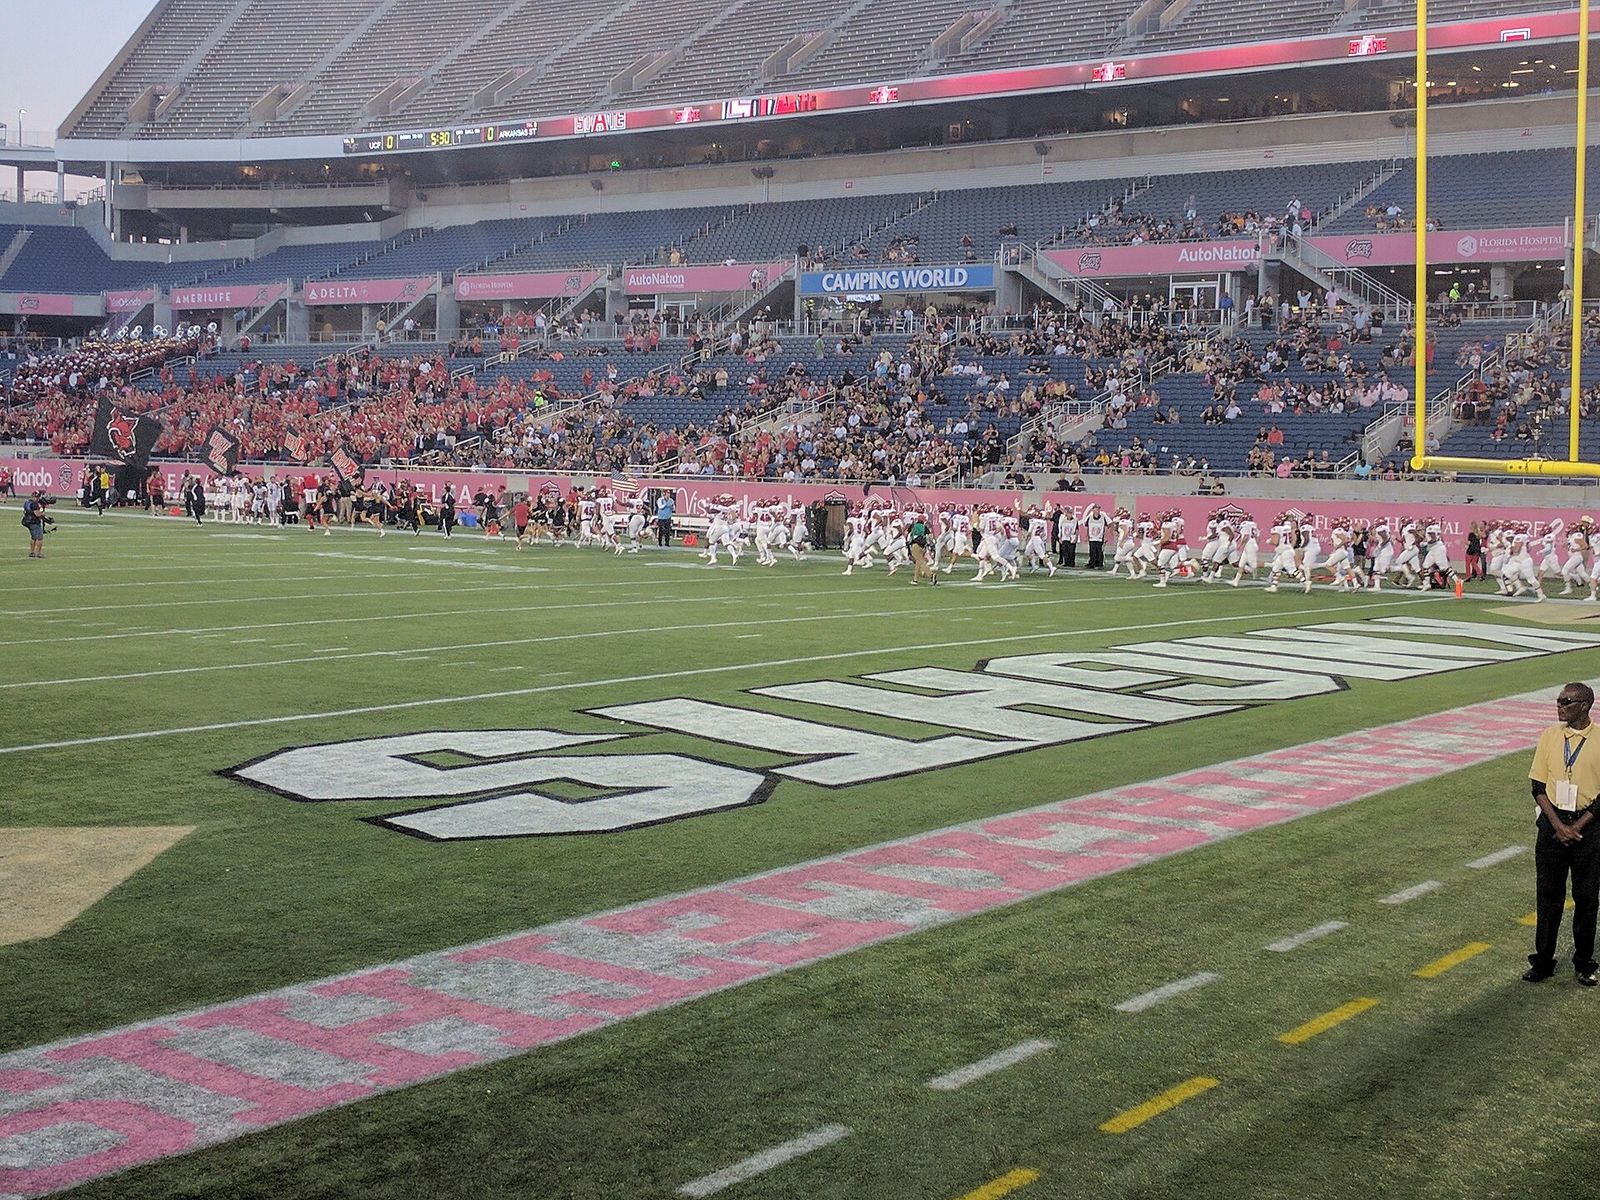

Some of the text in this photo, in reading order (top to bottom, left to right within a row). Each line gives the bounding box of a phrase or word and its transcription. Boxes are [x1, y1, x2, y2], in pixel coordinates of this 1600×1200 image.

[574, 111, 626, 134] STATE
[431, 131, 450, 146] 5:30
[487, 127, 494, 141] 0
[499, 127, 537, 139] ARKANSAS ST
[368, 141, 382, 149] UCF
[386, 136, 394, 150] 0
[1480, 235, 1562, 248] FLORIDA HOSPITAL
[1178, 246, 1261, 263] AutoNation
[628, 272, 684, 286] AutoNation
[822, 267, 968, 292] CAMPING WORLD
[175, 292, 232, 305] AMERILIFE
[320, 286, 358, 299] DELTA
[12, 470, 52, 488] rlando
